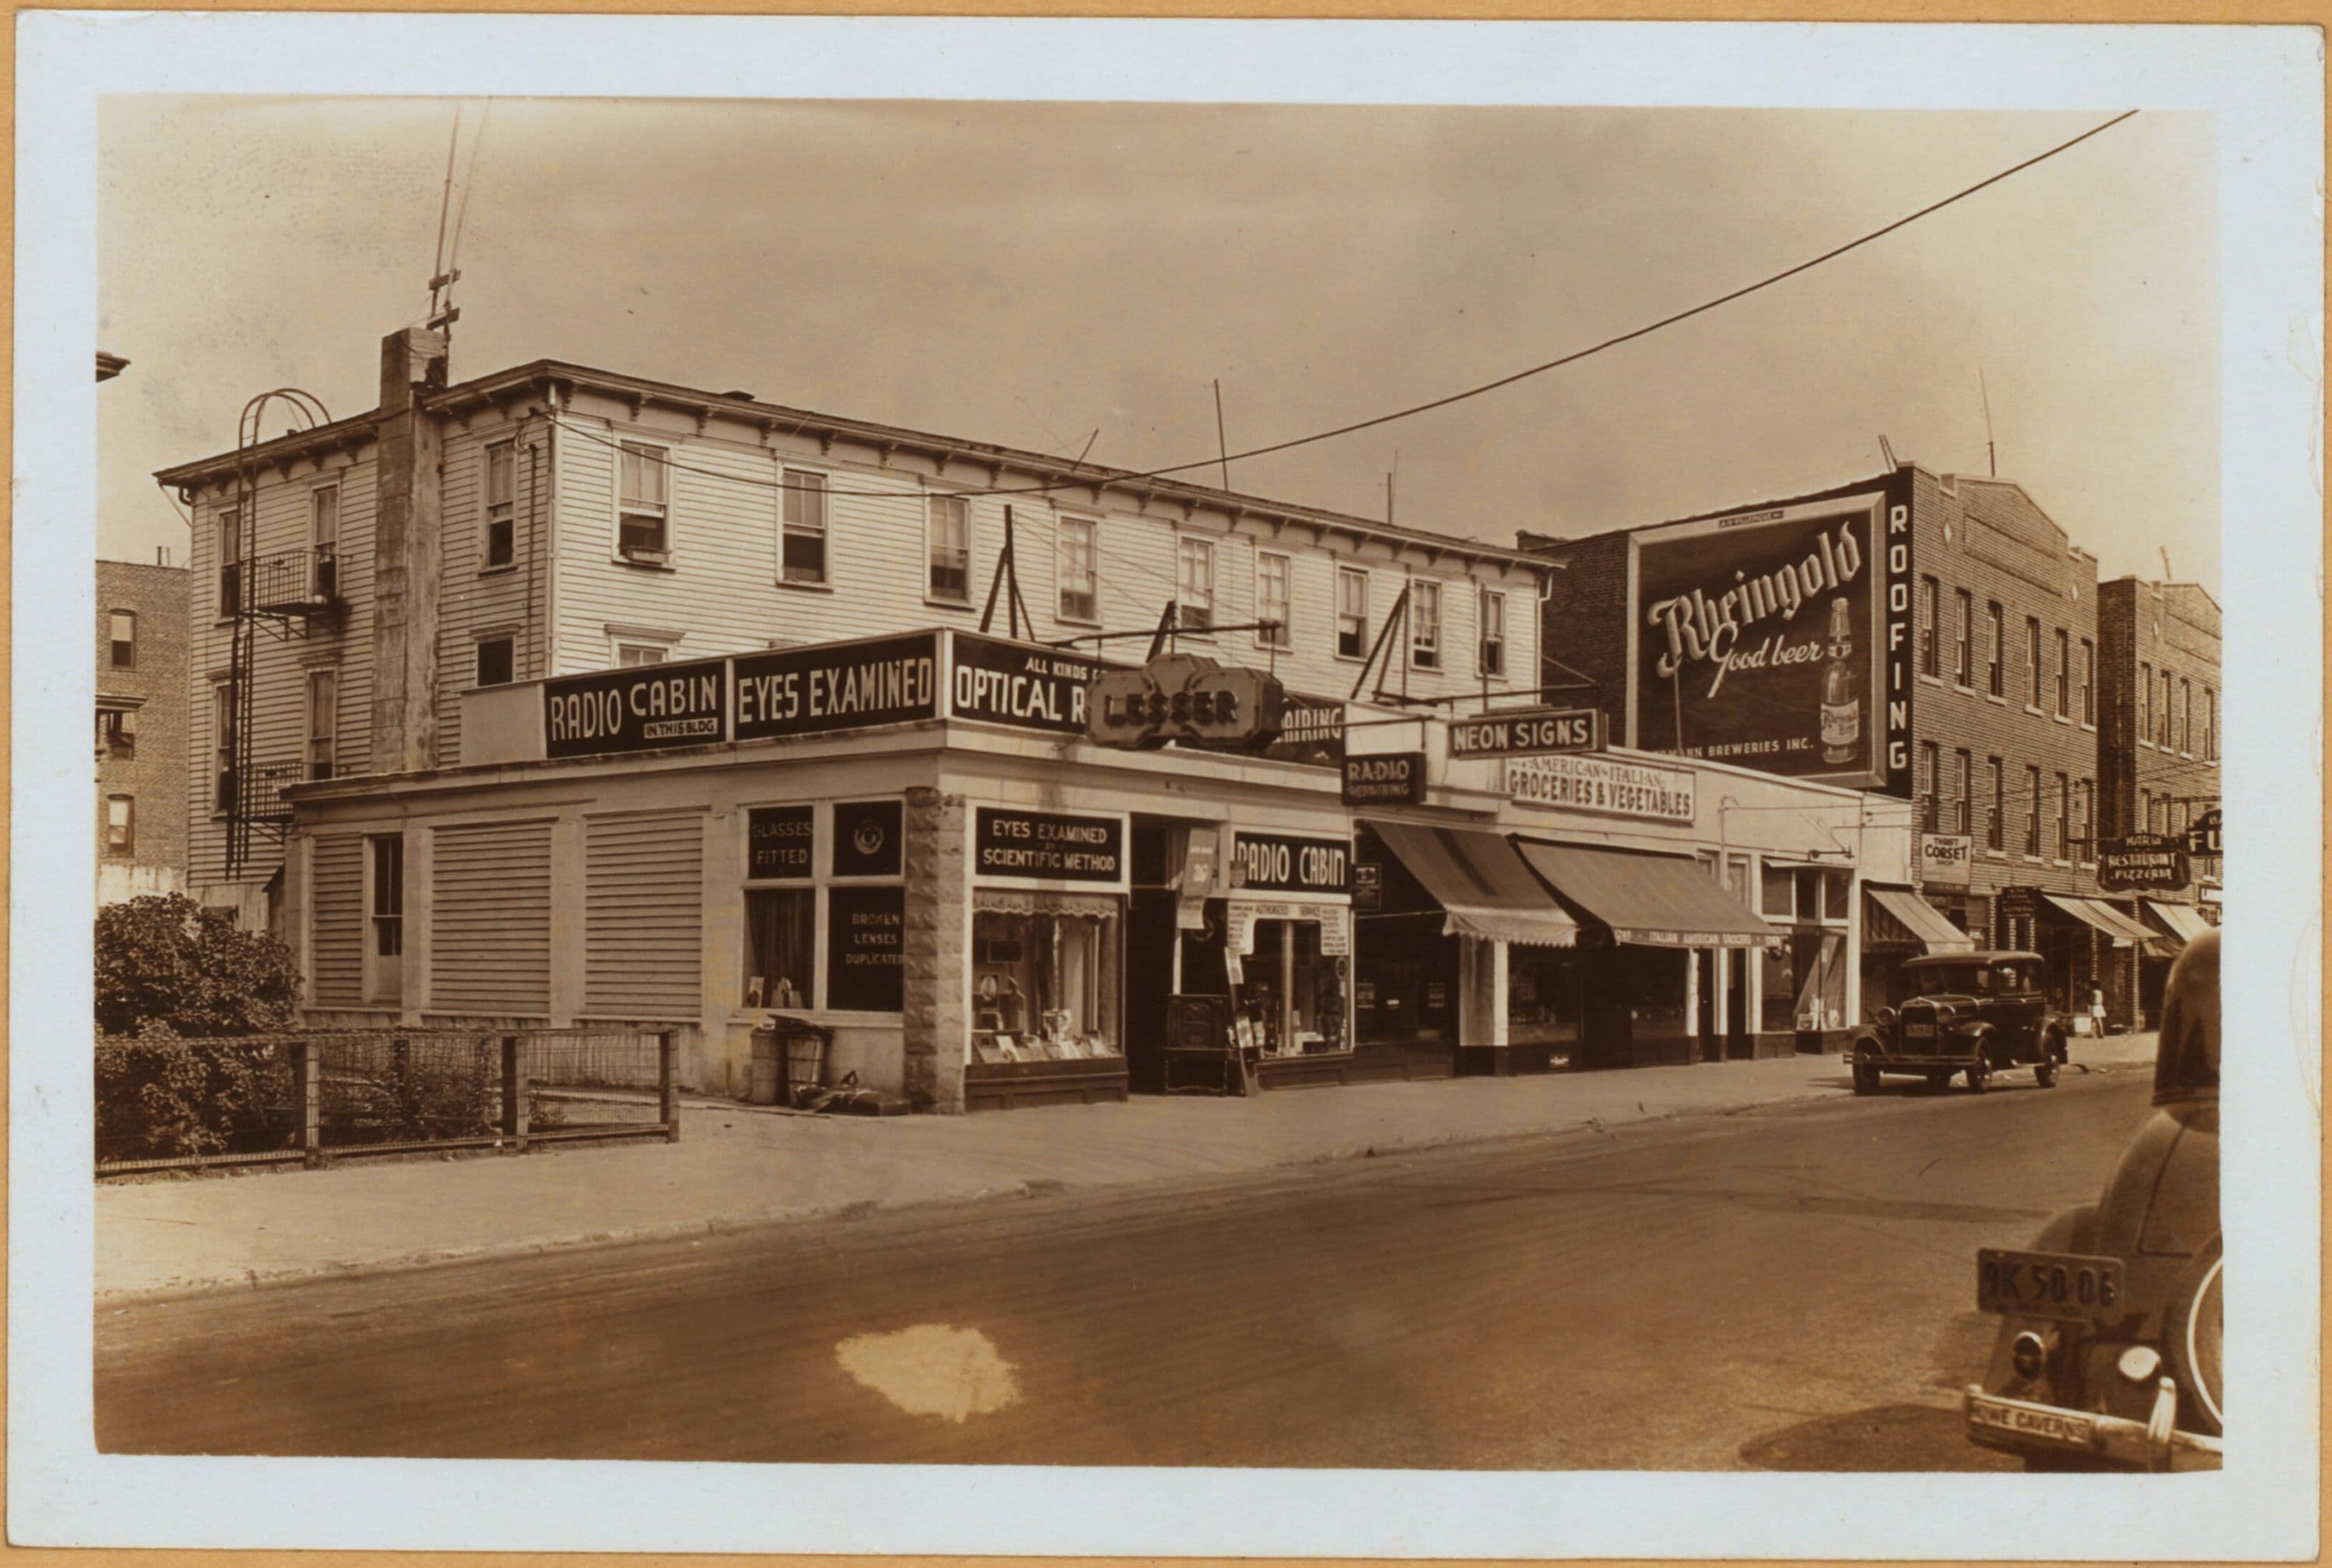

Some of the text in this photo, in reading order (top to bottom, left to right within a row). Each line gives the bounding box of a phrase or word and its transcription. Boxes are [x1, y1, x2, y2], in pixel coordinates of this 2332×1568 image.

[1648, 521, 1861, 678] Rheingold
[1890, 505, 1908, 770] ROOFING
[1025, 656, 1048, 674] ALL
[1053, 660, 1088, 680] KINDS
[1707, 621, 1824, 699] Good beer
[738, 656, 932, 724] EYES EXAMINED
[955, 666, 1062, 721] OPTICAL
[551, 673, 717, 742] RADIO CABIN
[1104, 690, 1239, 728] LESSER
[646, 719, 714, 737] IN THIS BLDG
[1453, 718, 1589, 751] NEON SIGNS
[1708, 739, 1780, 757] BREWERIES
[1787, 738, 1815, 750] INC.
[1348, 760, 1410, 781] RADIO
[1509, 769, 1690, 815] GROCERIES & VEGETABLES
[752, 821, 813, 838] GLASSES
[992, 819, 1107, 844] EYES EXAMINED
[757, 849, 808, 864] FITTED
[983, 847, 1116, 872] SCIENTIFIC METHOD
[1925, 843, 1968, 860] CORSET
[1300, 846, 1345, 886] CABIN
[2114, 868, 2172, 881] PIZZERIA
[851, 913, 900, 925] BROKEN
[854, 933, 897, 945] LENSES
